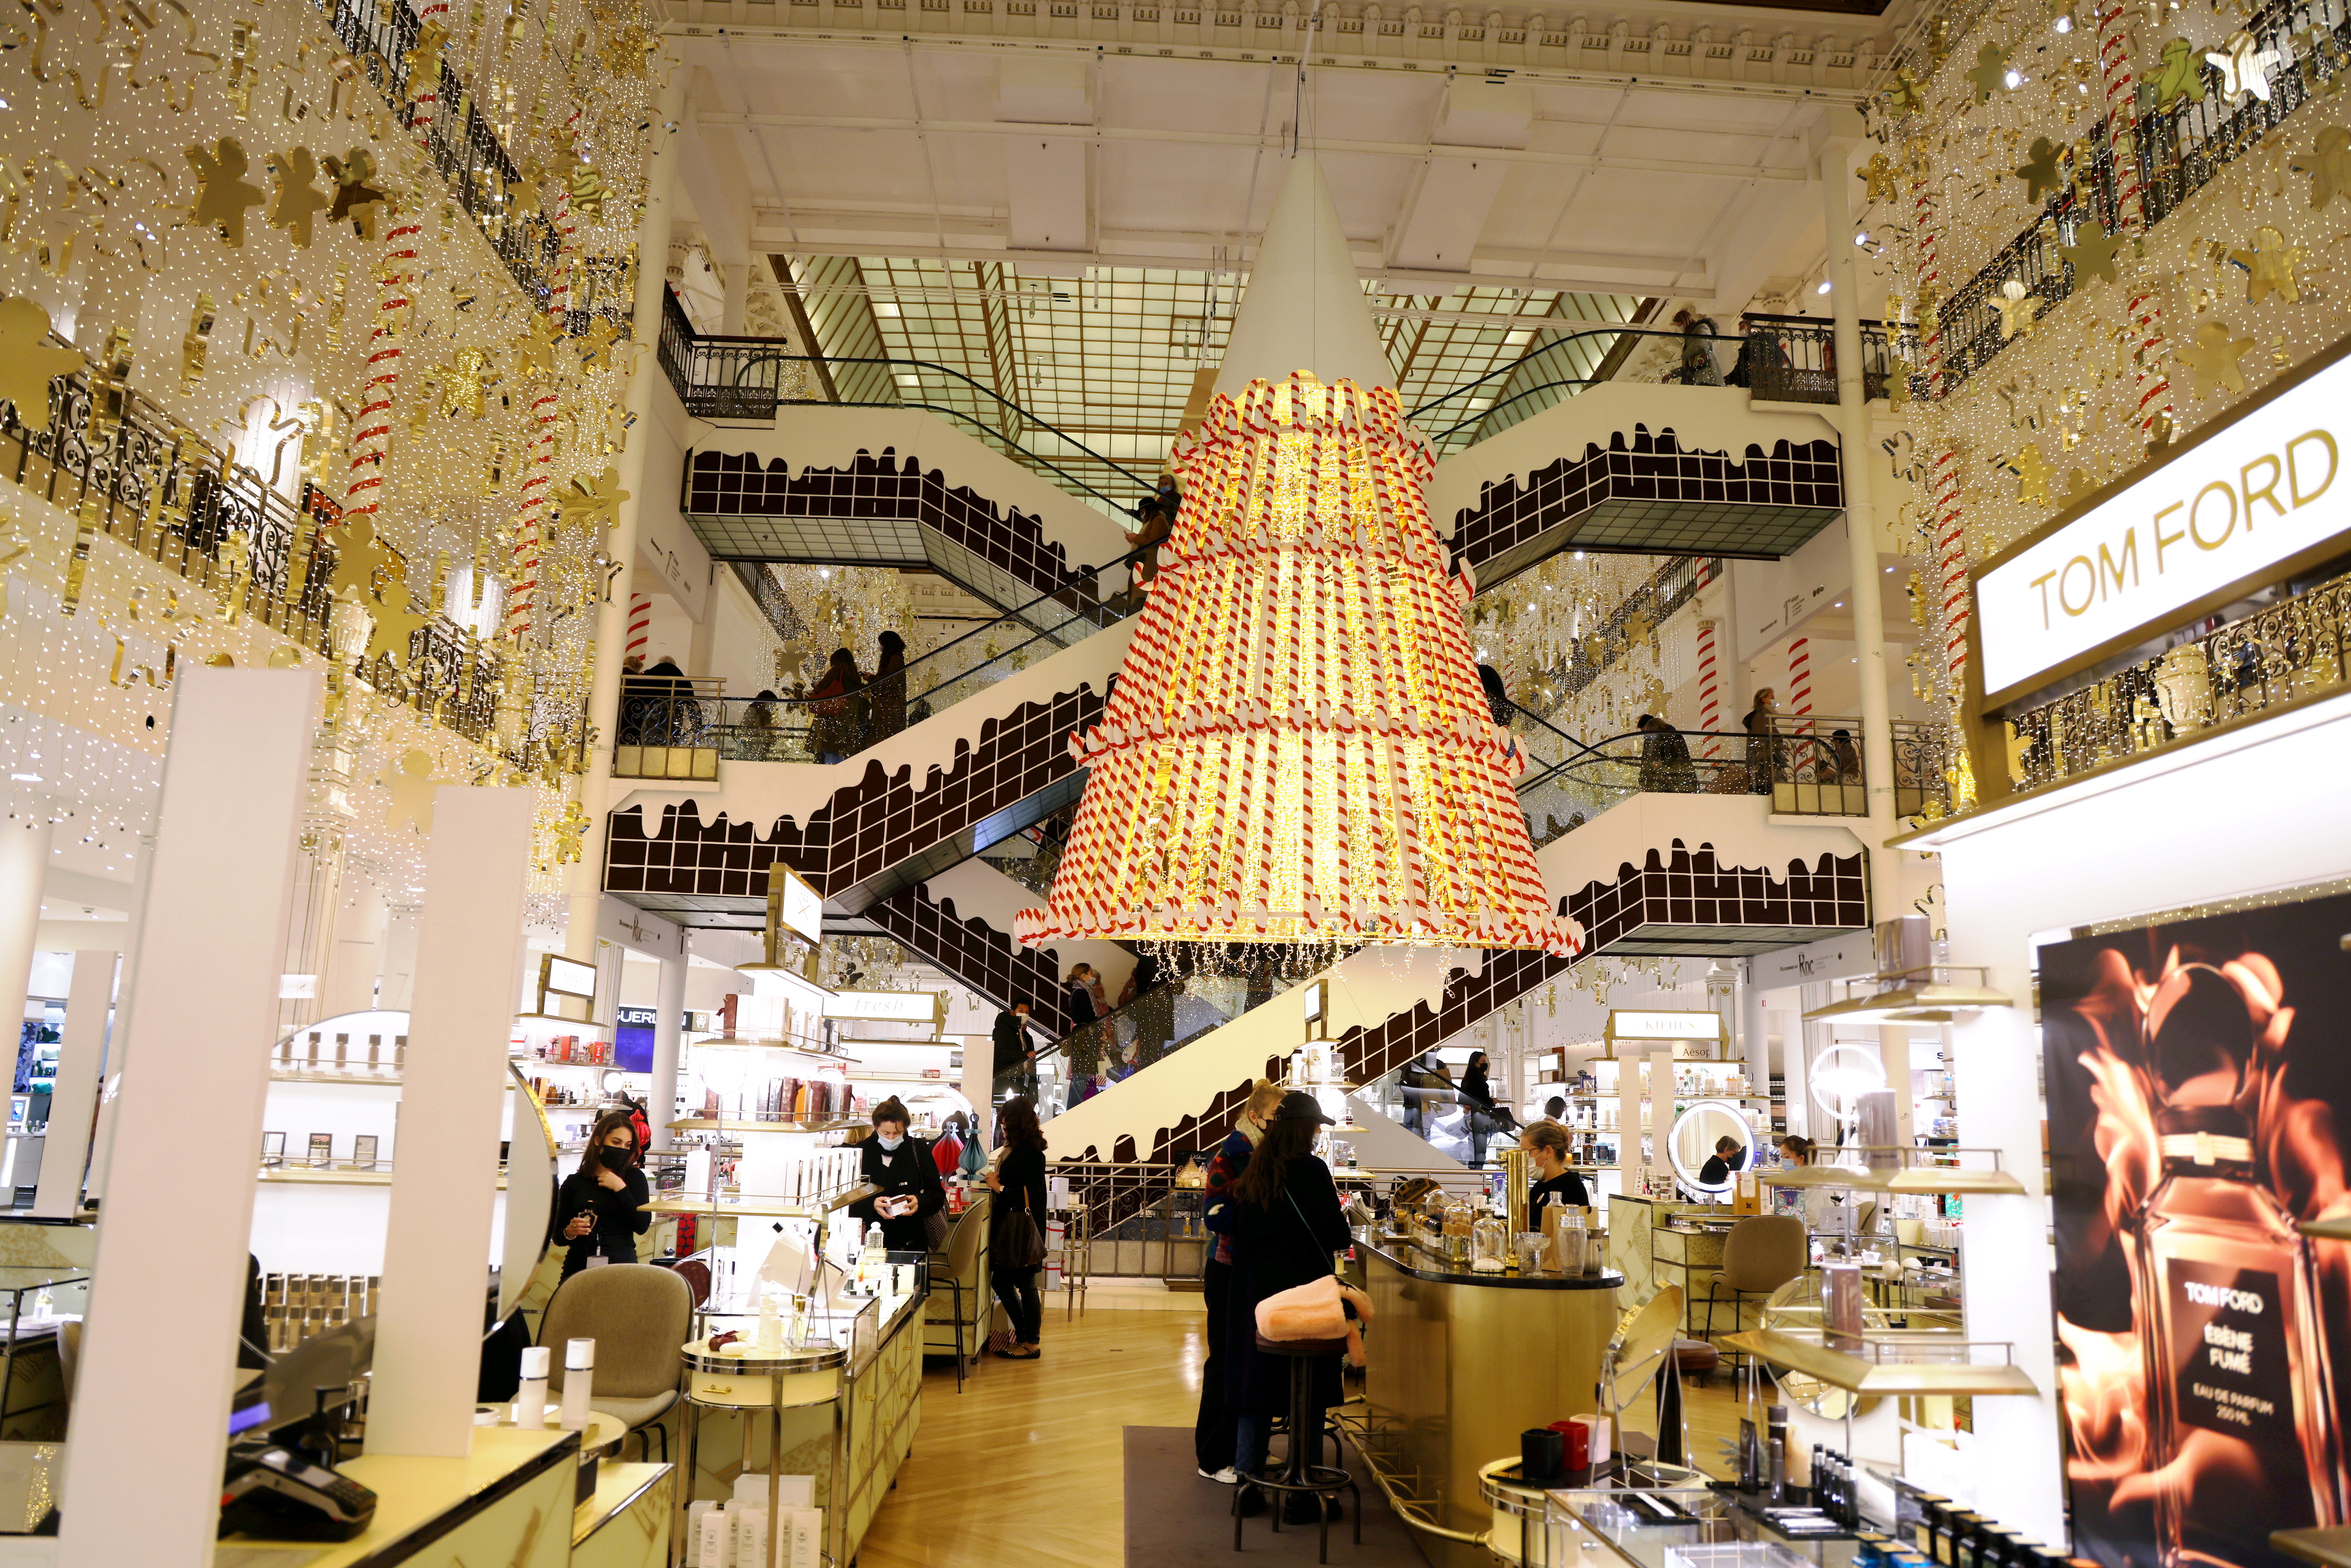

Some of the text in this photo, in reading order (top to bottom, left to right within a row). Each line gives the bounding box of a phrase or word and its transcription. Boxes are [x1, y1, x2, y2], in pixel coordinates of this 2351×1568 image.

[2030, 429, 2339, 630] TOM FORD
[854, 997, 903, 1013] fresh
[2184, 1282, 2264, 1314] TOM FORD
[2209, 1347, 2253, 1375] FUMÉ
[2193, 1382, 2275, 1416] EAU DE PARFUM
